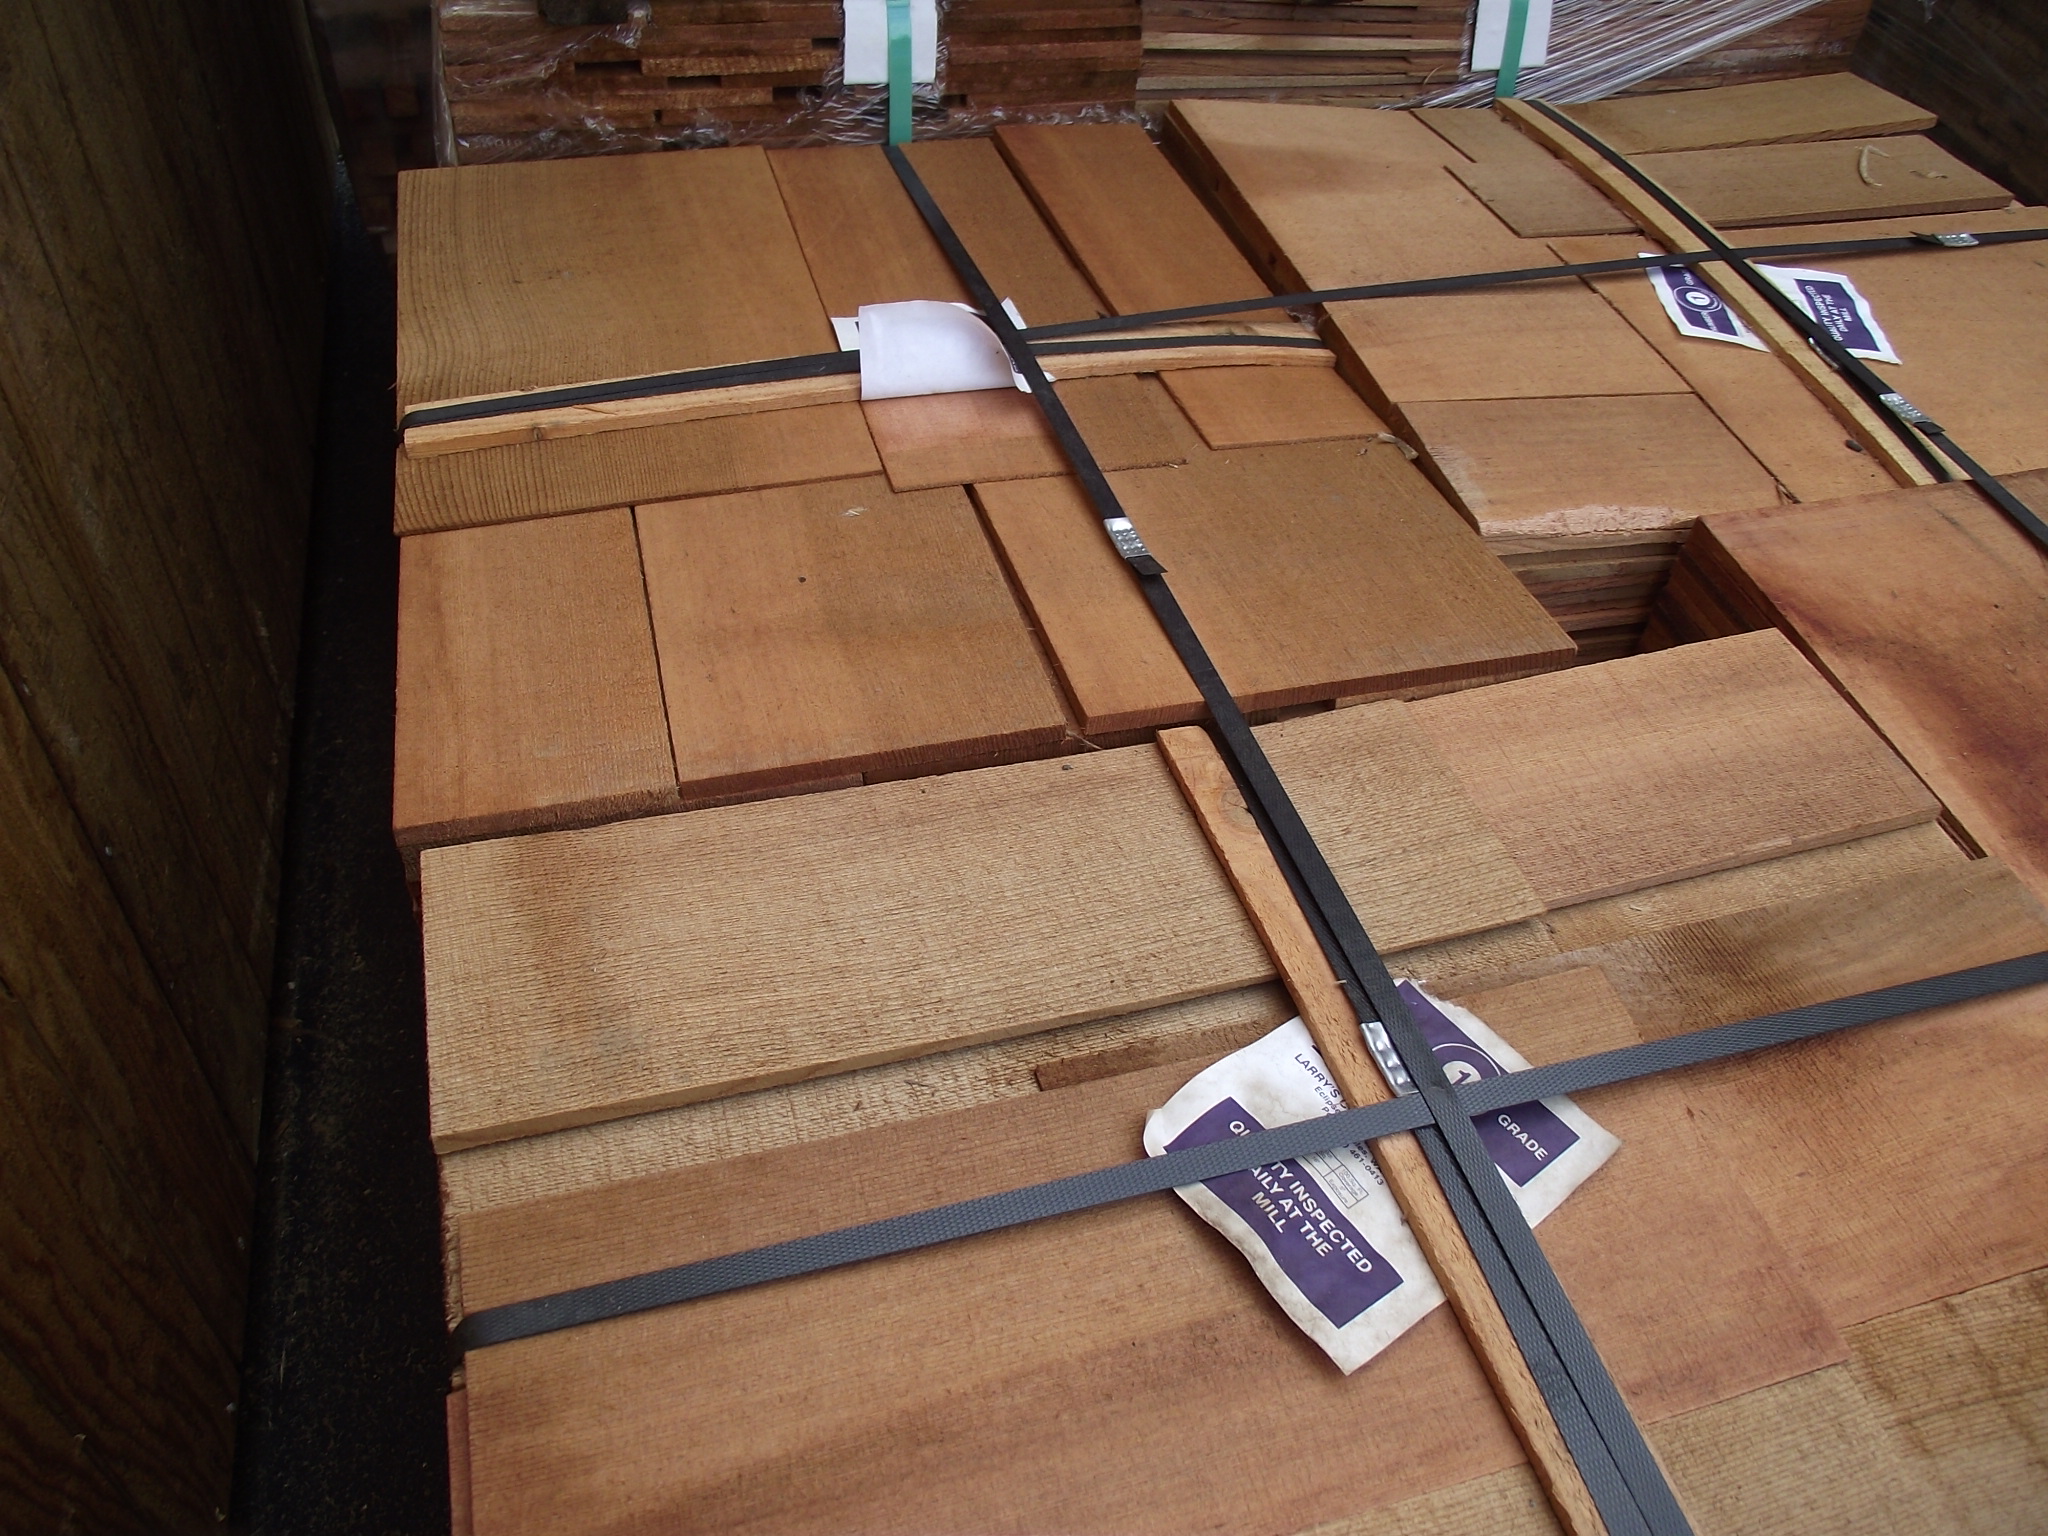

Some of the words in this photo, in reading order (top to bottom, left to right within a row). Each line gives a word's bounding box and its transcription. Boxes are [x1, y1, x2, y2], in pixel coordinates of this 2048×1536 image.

[1804, 285, 1830, 317] INSPECTED
[1822, 294, 1835, 306] THE
[1828, 306, 1838, 316] AT
[1839, 308, 1853, 322] MILL
[1822, 317, 1844, 342] QUALITY
[1832, 315, 1849, 333] DAILY
[1294, 1053, 1341, 1098] LARRY'S
[1497, 1113, 1549, 1161] GRADE
[1350, 1149, 1385, 1186] 461-0413
[1251, 1190, 1286, 1234] MILL
[1278, 1197, 1302, 1220] AT
[1300, 1220, 1333, 1258] THE
[1289, 1178, 1373, 1273] INSPECTED
